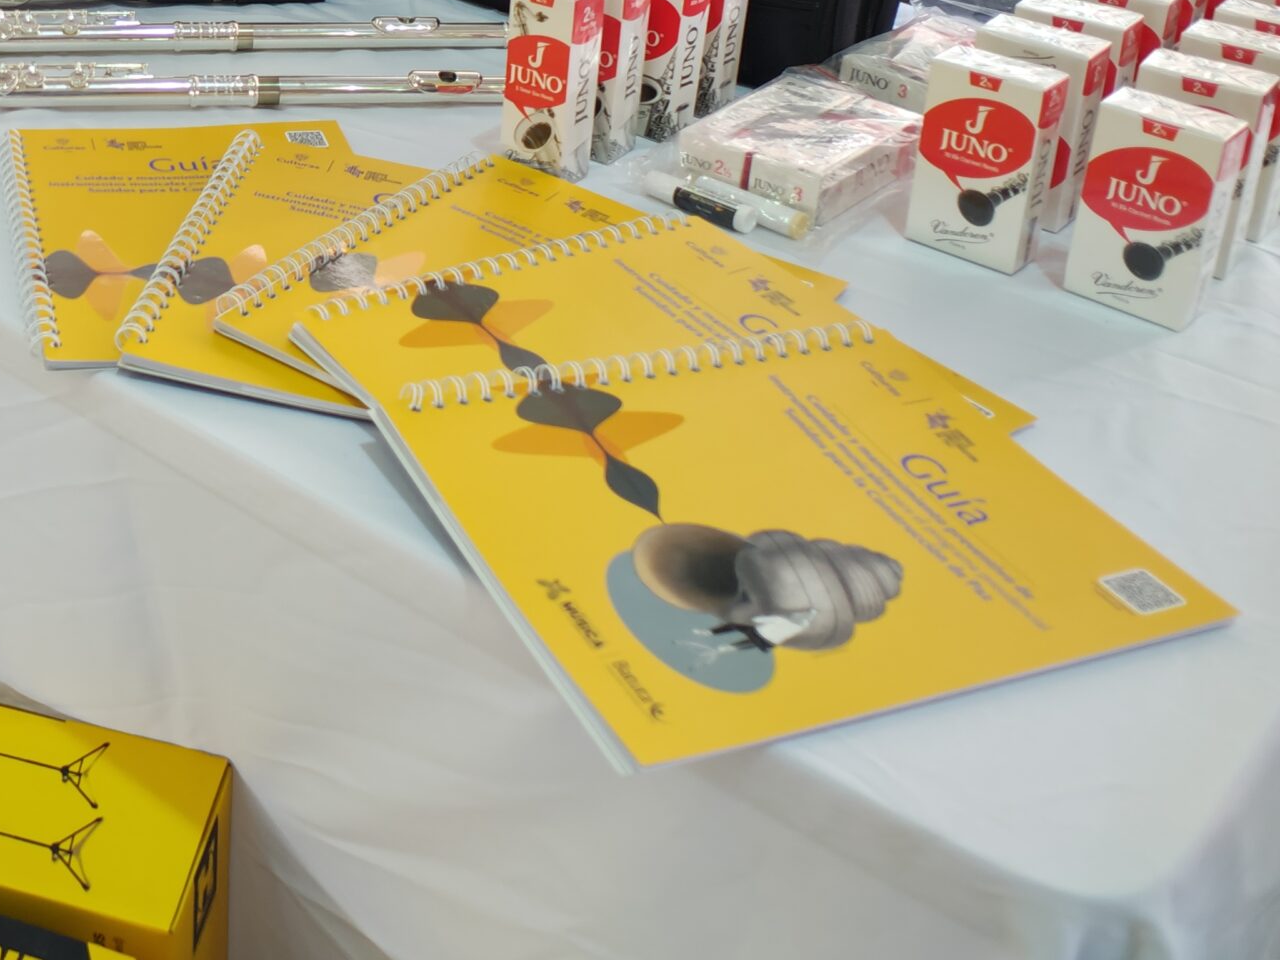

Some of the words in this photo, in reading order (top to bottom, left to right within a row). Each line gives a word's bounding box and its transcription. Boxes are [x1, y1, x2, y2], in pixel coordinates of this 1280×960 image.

[723, 6, 741, 66] JUNO
[1235, 49, 1244, 60] 3
[679, 25, 699, 89] JUNO
[509, 64, 564, 94] JUNO
[574, 58, 590, 125] JUNO
[850, 68, 889, 90] JUNO
[897, 84, 909, 98] 3
[939, 127, 1008, 163] JUNO
[753, 178, 785, 197] JUNO
[793, 186, 804, 202] 3
[1106, 177, 1183, 216] JUNO
[900, 453, 990, 527] Guía
